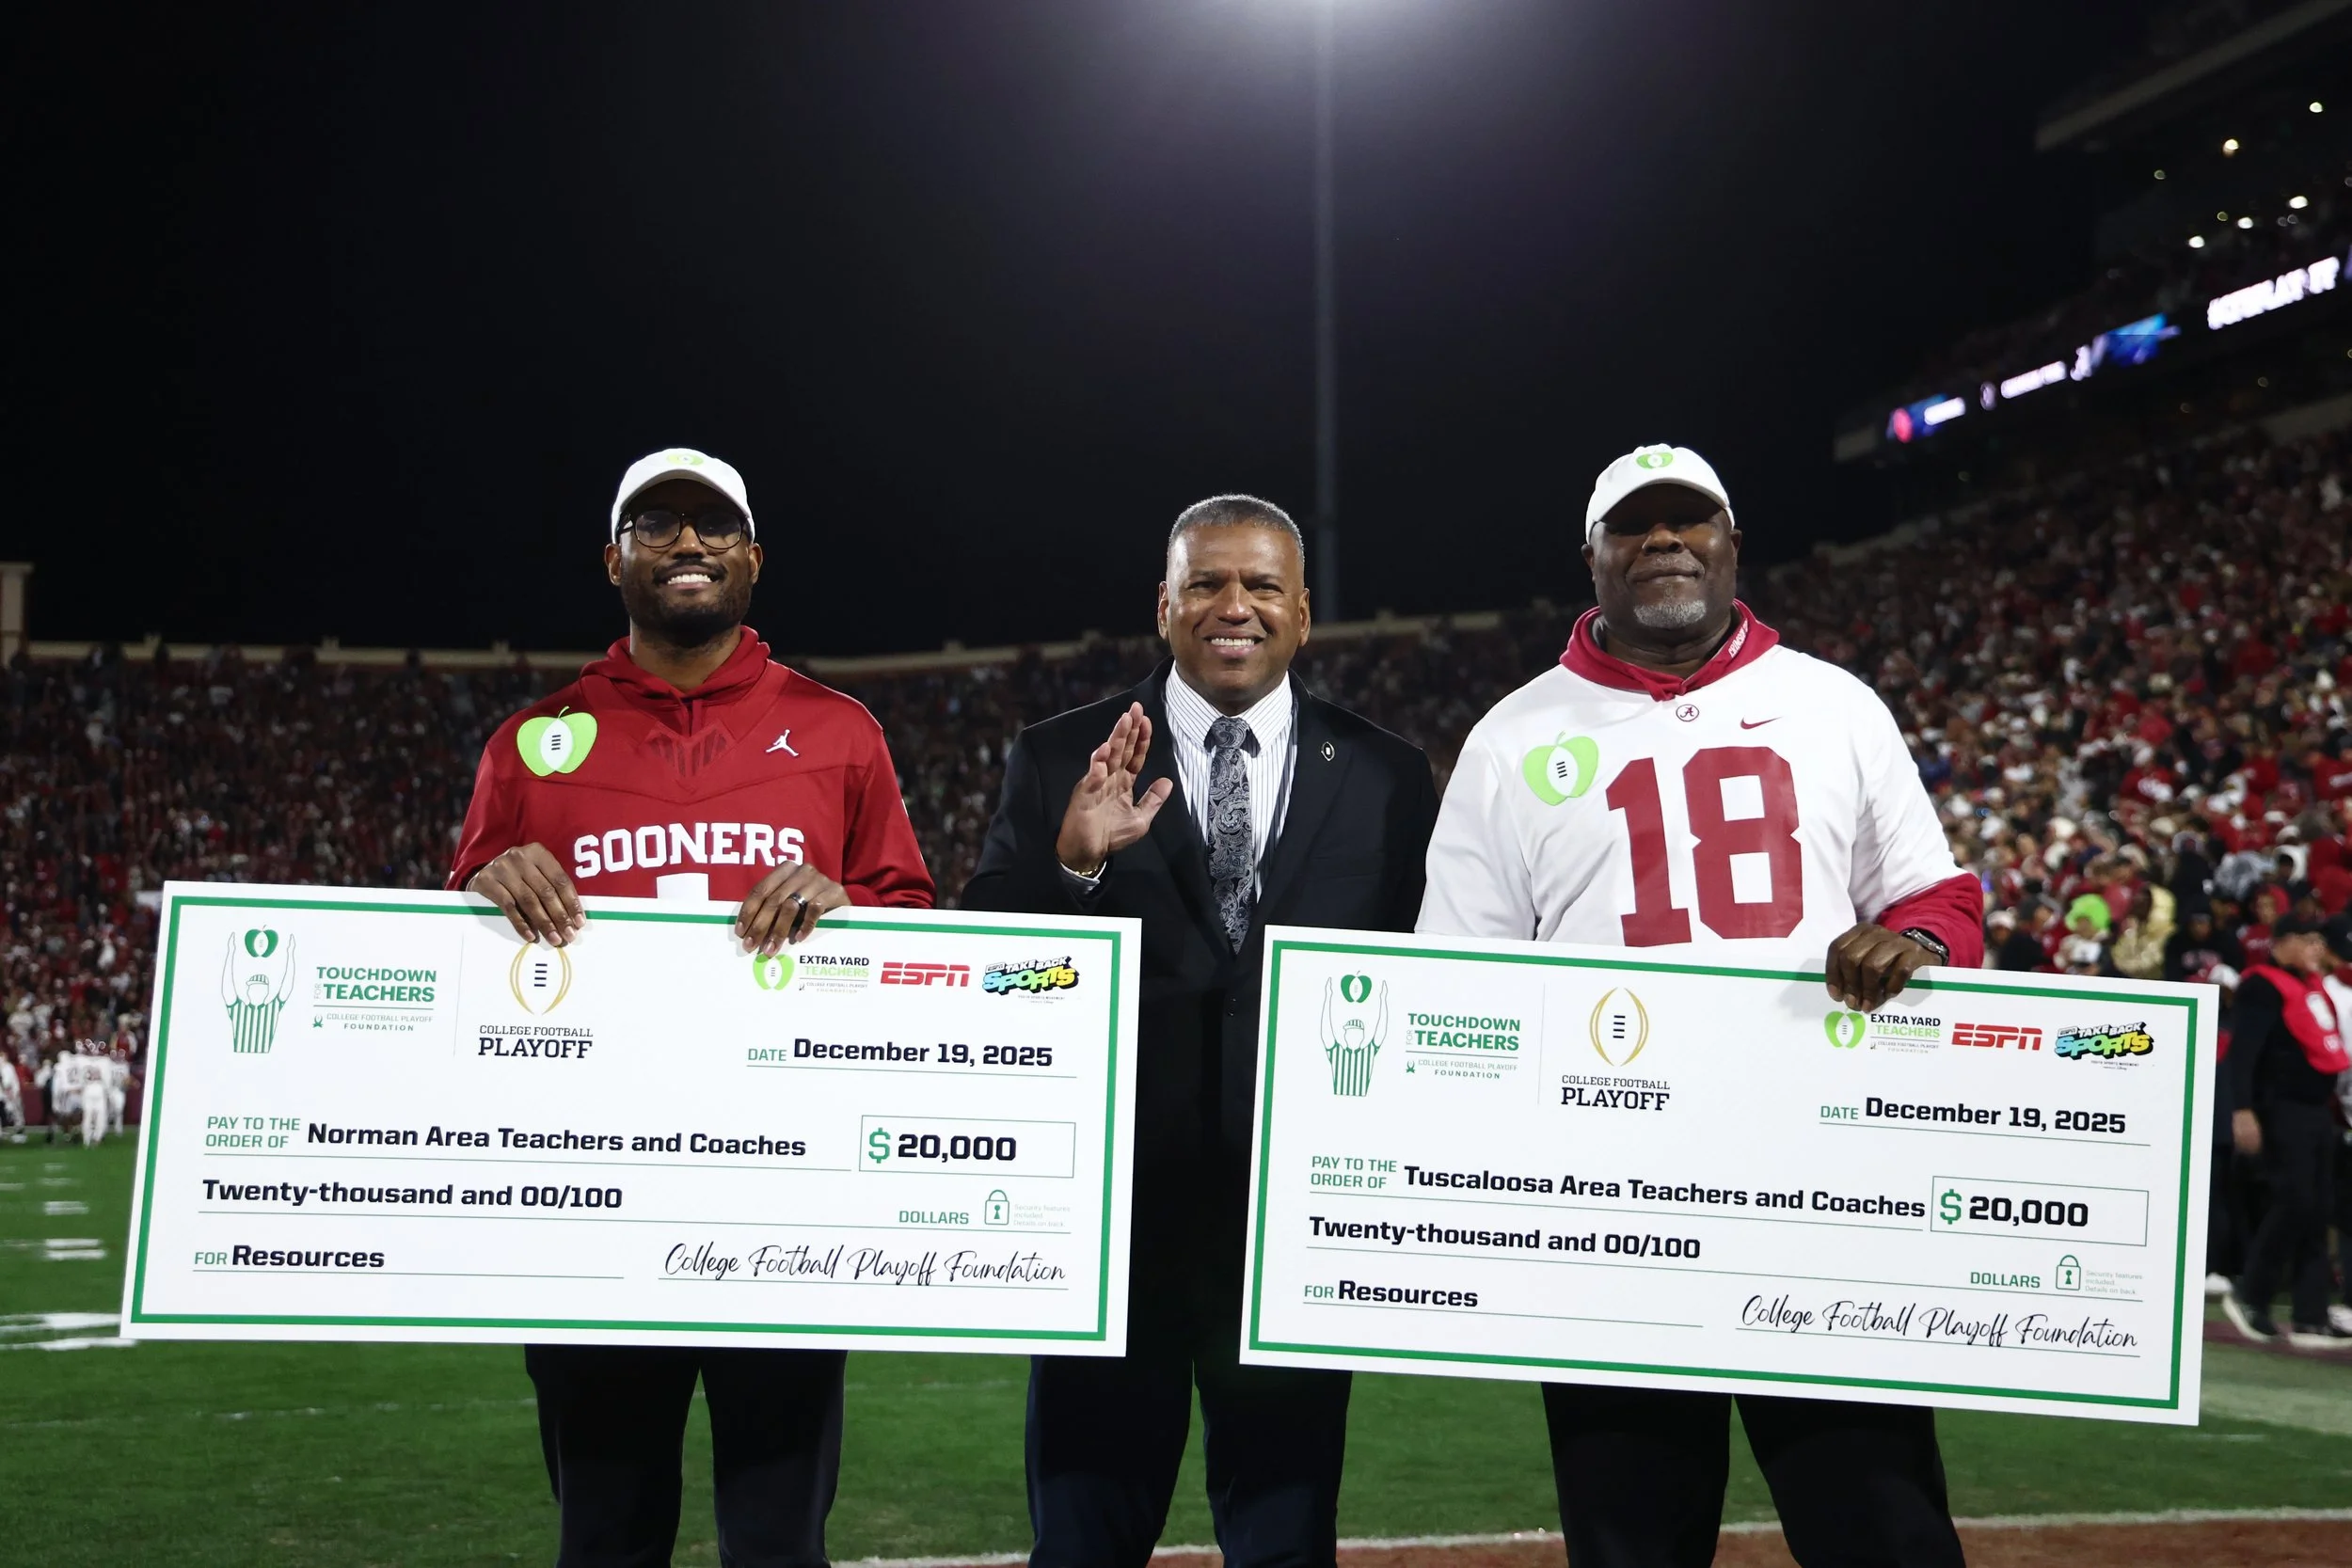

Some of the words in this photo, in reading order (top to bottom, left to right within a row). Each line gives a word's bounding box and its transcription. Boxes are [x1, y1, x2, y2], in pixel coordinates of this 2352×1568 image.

[574, 822, 804, 879] SOONERS
[1606, 746, 1804, 948] 18
[800, 956, 837, 965] EXTRA
[839, 957, 870, 966] YARD
[804, 966, 869, 977] TEACHERS
[1006, 959, 1037, 974] TAKE
[1035, 956, 1072, 971] BACK
[316, 966, 437, 982] TOUCHDOWN
[881, 962, 970, 988] ESPN
[982, 966, 1080, 995] SPORTS
[323, 983, 435, 1003] TEACHERS
[343, 1022, 414, 1032] FOUNDATION
[479, 1024, 532, 1036] COLLEGE
[533, 1026, 594, 1037] FOOTBALL
[1407, 1013, 1520, 1031] TOUCHDOWN
[1871, 1014, 1908, 1025] EXTRA
[1911, 1017, 1940, 1027] YARD
[2078, 1024, 2110, 1038] TAKE
[2108, 1022, 2146, 1037] BACK
[1414, 1030, 1519, 1051] TEACHERS
[1876, 1025, 1940, 1038] TEACHERS
[1951, 1023, 2042, 1052] ESPN
[478, 1037, 593, 1059] PLAYOFF
[748, 1048, 787, 1061] DATE
[794, 1038, 930, 1063] December
[937, 1043, 976, 1068] 19,
[983, 1045, 1053, 1067] 2025
[2055, 1031, 2154, 1060] SPORTS
[1434, 1069, 1501, 1079] FOUNDATION
[1487, 1063, 1518, 1071] PLAYOFF
[1562, 1074, 1611, 1086] COLLEGE
[1613, 1078, 1670, 1089] FOOTBALL
[1561, 1087, 1670, 1110] PLAYOFF
[208, 1117, 238, 1131] PAY
[242, 1117, 264, 1131] TO
[269, 1117, 301, 1132] THE
[1820, 1106, 1859, 1119] DATE
[1866, 1097, 2000, 1127] December
[2009, 1106, 2047, 1131] 19,
[2055, 1110, 2126, 1133] 2025
[206, 1133, 262, 1148] ORDER
[267, 1134, 289, 1148] OF
[308, 1123, 418, 1146] Norman
[425, 1126, 490, 1148] Area
[498, 1129, 623, 1151] Teachers
[632, 1134, 681, 1153] and
[689, 1133, 805, 1156] Coaches
[867, 1127, 890, 1164] $
[898, 1133, 1016, 1163] 20,000
[1311, 1156, 1340, 1169] PAY
[1343, 1157, 1364, 1170] TO
[1368, 1159, 1398, 1173] THE
[1311, 1173, 1364, 1187] ORDER
[1367, 1176, 1387, 1189] OF
[1405, 1165, 1554, 1193] Tuscaloosa
[1560, 1176, 1620, 1198] Area
[1628, 1179, 1748, 1206] Teachers
[1756, 1189, 1804, 1210] and
[1812, 1191, 1925, 1217] Coaches
[203, 1180, 452, 1206] Twenty-thousand
[461, 1185, 512, 1206] and
[520, 1185, 623, 1209] 00/100
[899, 1211, 969, 1225] DOLLARS
[1940, 1189, 1963, 1225] $
[1969, 1196, 2089, 1227] 20,000
[1310, 1217, 1541, 1249] Twenty-thousand
[1548, 1232, 1596, 1253] and
[1604, 1234, 1700, 1259] 00/100
[194, 1252, 228, 1265] FOR
[231, 1244, 385, 1268] Resources
[665, 1242, 739, 1281] College
[748, 1244, 843, 1280] Football
[847, 1248, 937, 1286] Playoff
[945, 1249, 1065, 1283] Foundation
[1970, 1272, 2040, 1289] DOLLARS
[1304, 1285, 1334, 1298] FOR
[1339, 1281, 1478, 1307] Resources
[1742, 1293, 1814, 1332] College
[1822, 1300, 1915, 1337] Football
[1918, 1307, 2007, 1347] Playoff
[2015, 1314, 2137, 1349] Foundation
